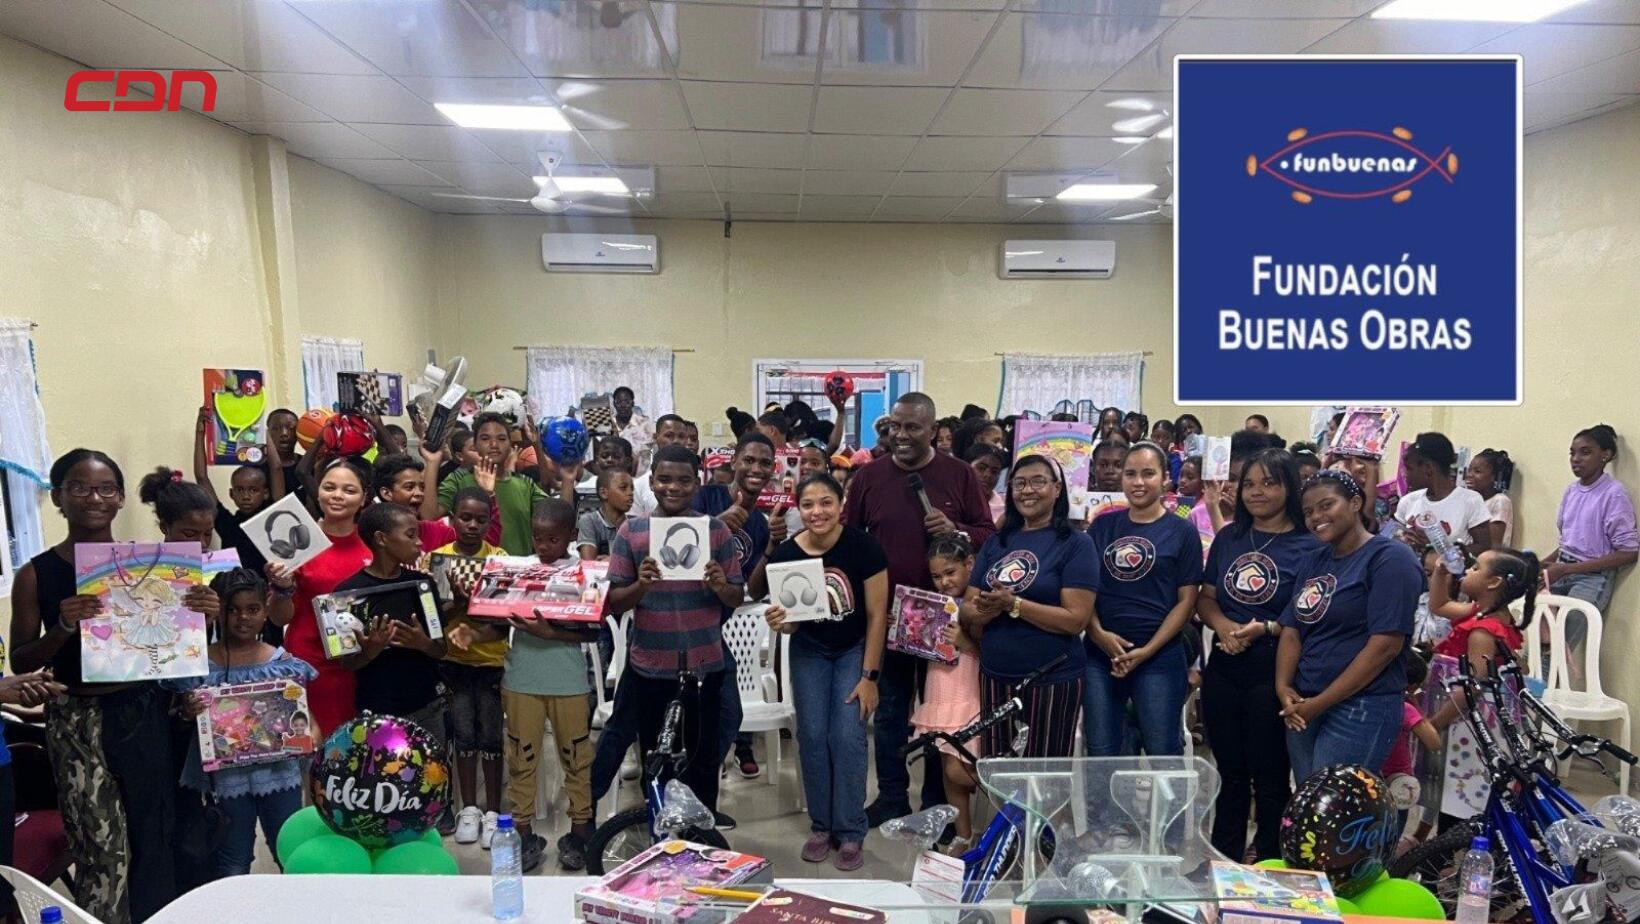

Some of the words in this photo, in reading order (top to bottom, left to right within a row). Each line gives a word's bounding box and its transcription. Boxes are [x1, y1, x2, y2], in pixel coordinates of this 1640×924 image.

[563, 604, 595, 616] GEL
[325, 774, 371, 812] Feliz
[374, 781, 422, 815] Día
